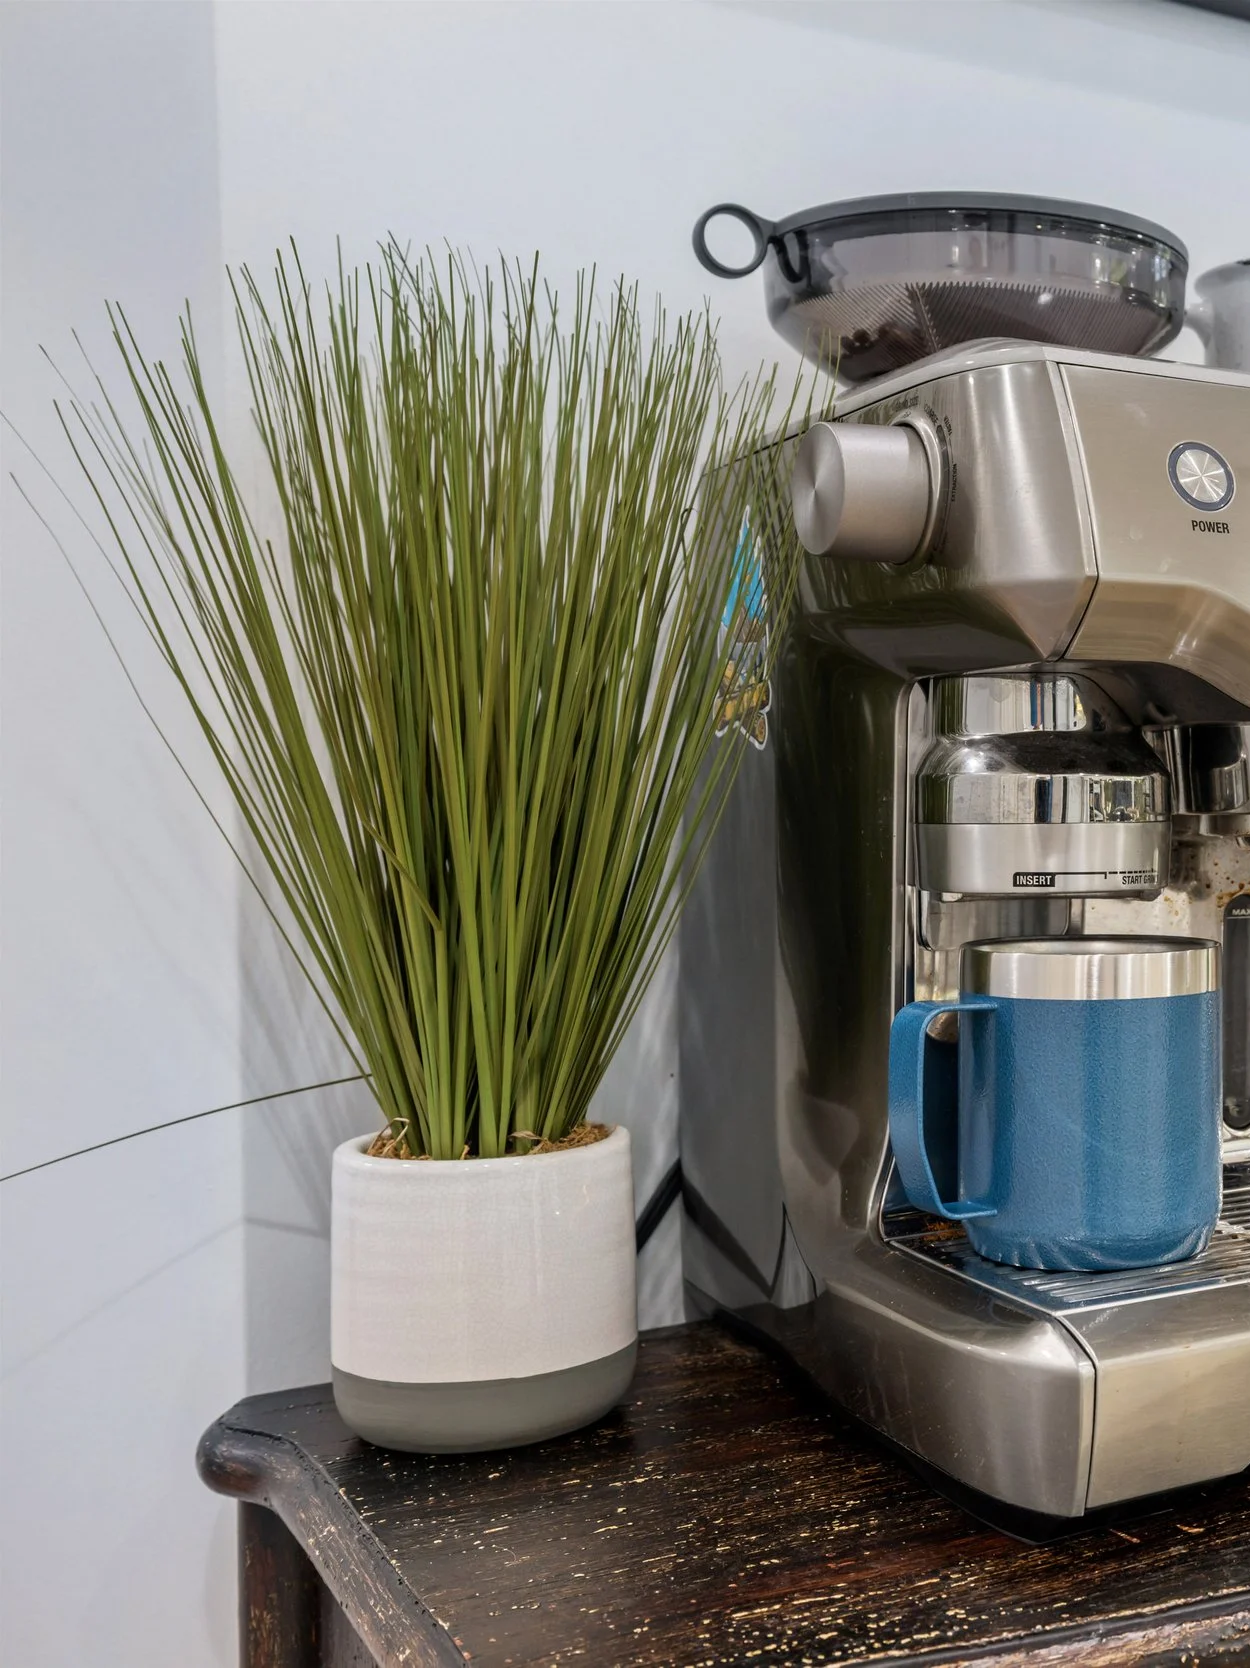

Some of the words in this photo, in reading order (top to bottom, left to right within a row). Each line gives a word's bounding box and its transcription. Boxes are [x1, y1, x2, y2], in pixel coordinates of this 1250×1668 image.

[1191, 519, 1230, 534] POWER
[1016, 875, 1052, 885] INSERT
[1122, 875, 1142, 885] START
